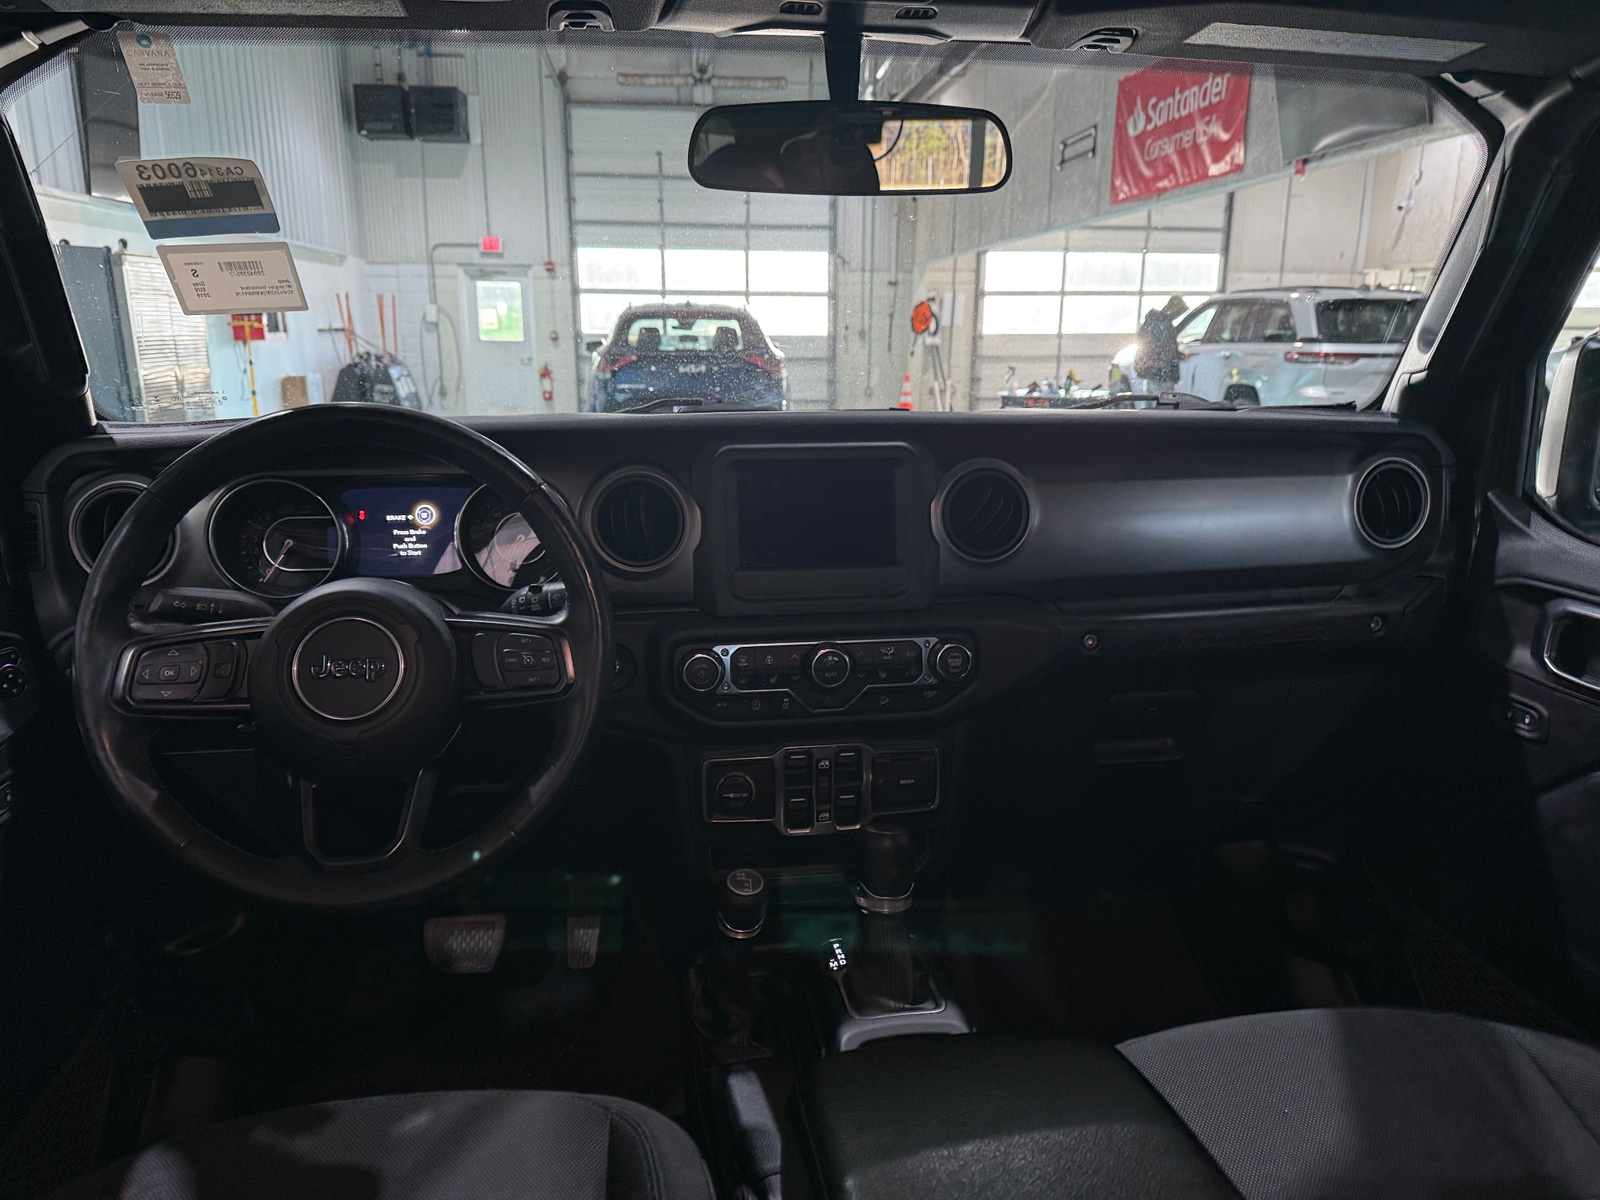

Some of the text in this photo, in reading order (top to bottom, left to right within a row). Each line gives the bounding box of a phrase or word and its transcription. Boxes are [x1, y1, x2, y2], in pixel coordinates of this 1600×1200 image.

[126, 49, 170, 58] CARVANA
[1147, 73, 1230, 131] Santander
[1143, 128, 1196, 161] Consumer
[409, 528, 427, 536] Brake
[164, 669, 178, 677] OK
[310, 654, 386, 681] Jeep
